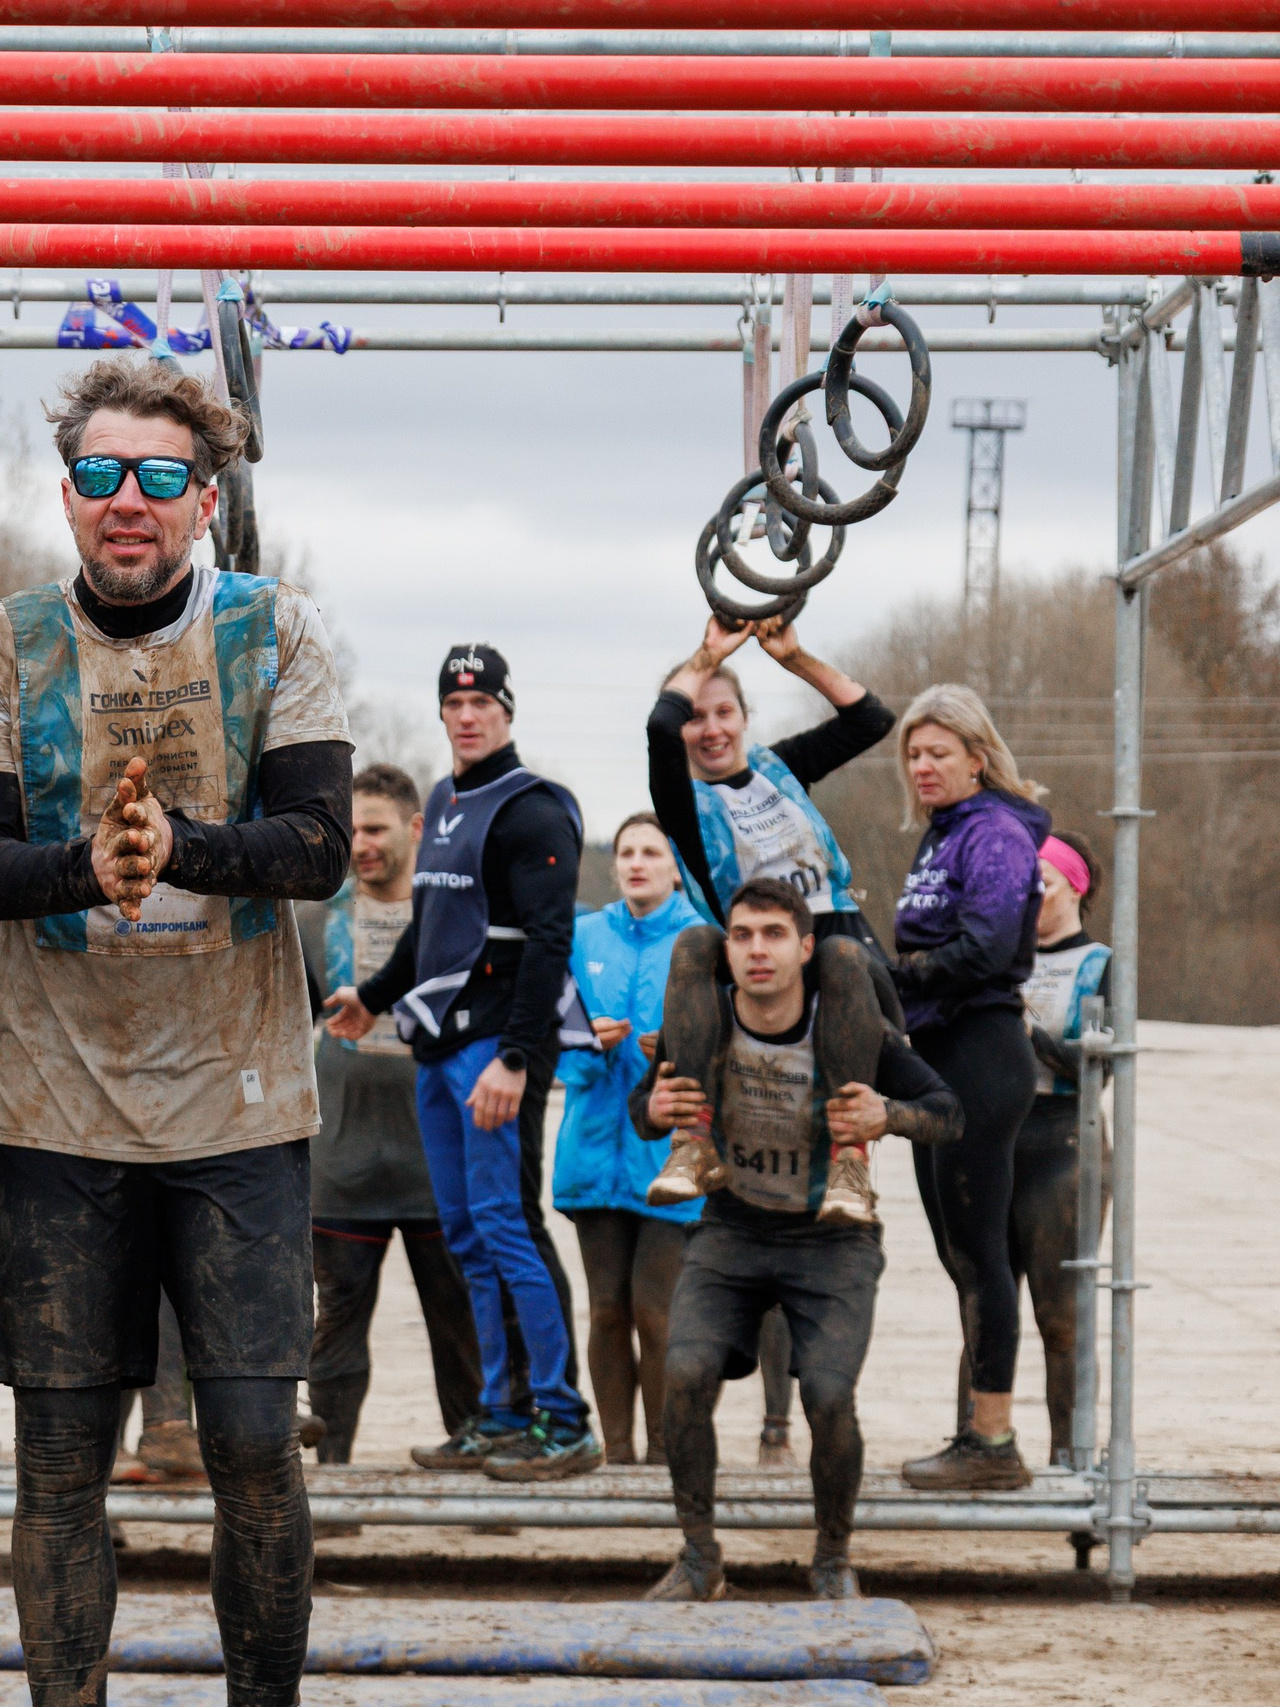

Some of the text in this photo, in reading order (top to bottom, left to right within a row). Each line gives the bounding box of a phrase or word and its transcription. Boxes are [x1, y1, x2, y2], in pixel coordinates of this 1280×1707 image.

[90, 680, 211, 709] ГОНКА ГЕРОЕВ
[107, 717, 196, 747] Sminex
[136, 920, 209, 933] ГАЗПРОМБАНК
[732, 1142, 799, 1176] 5411
